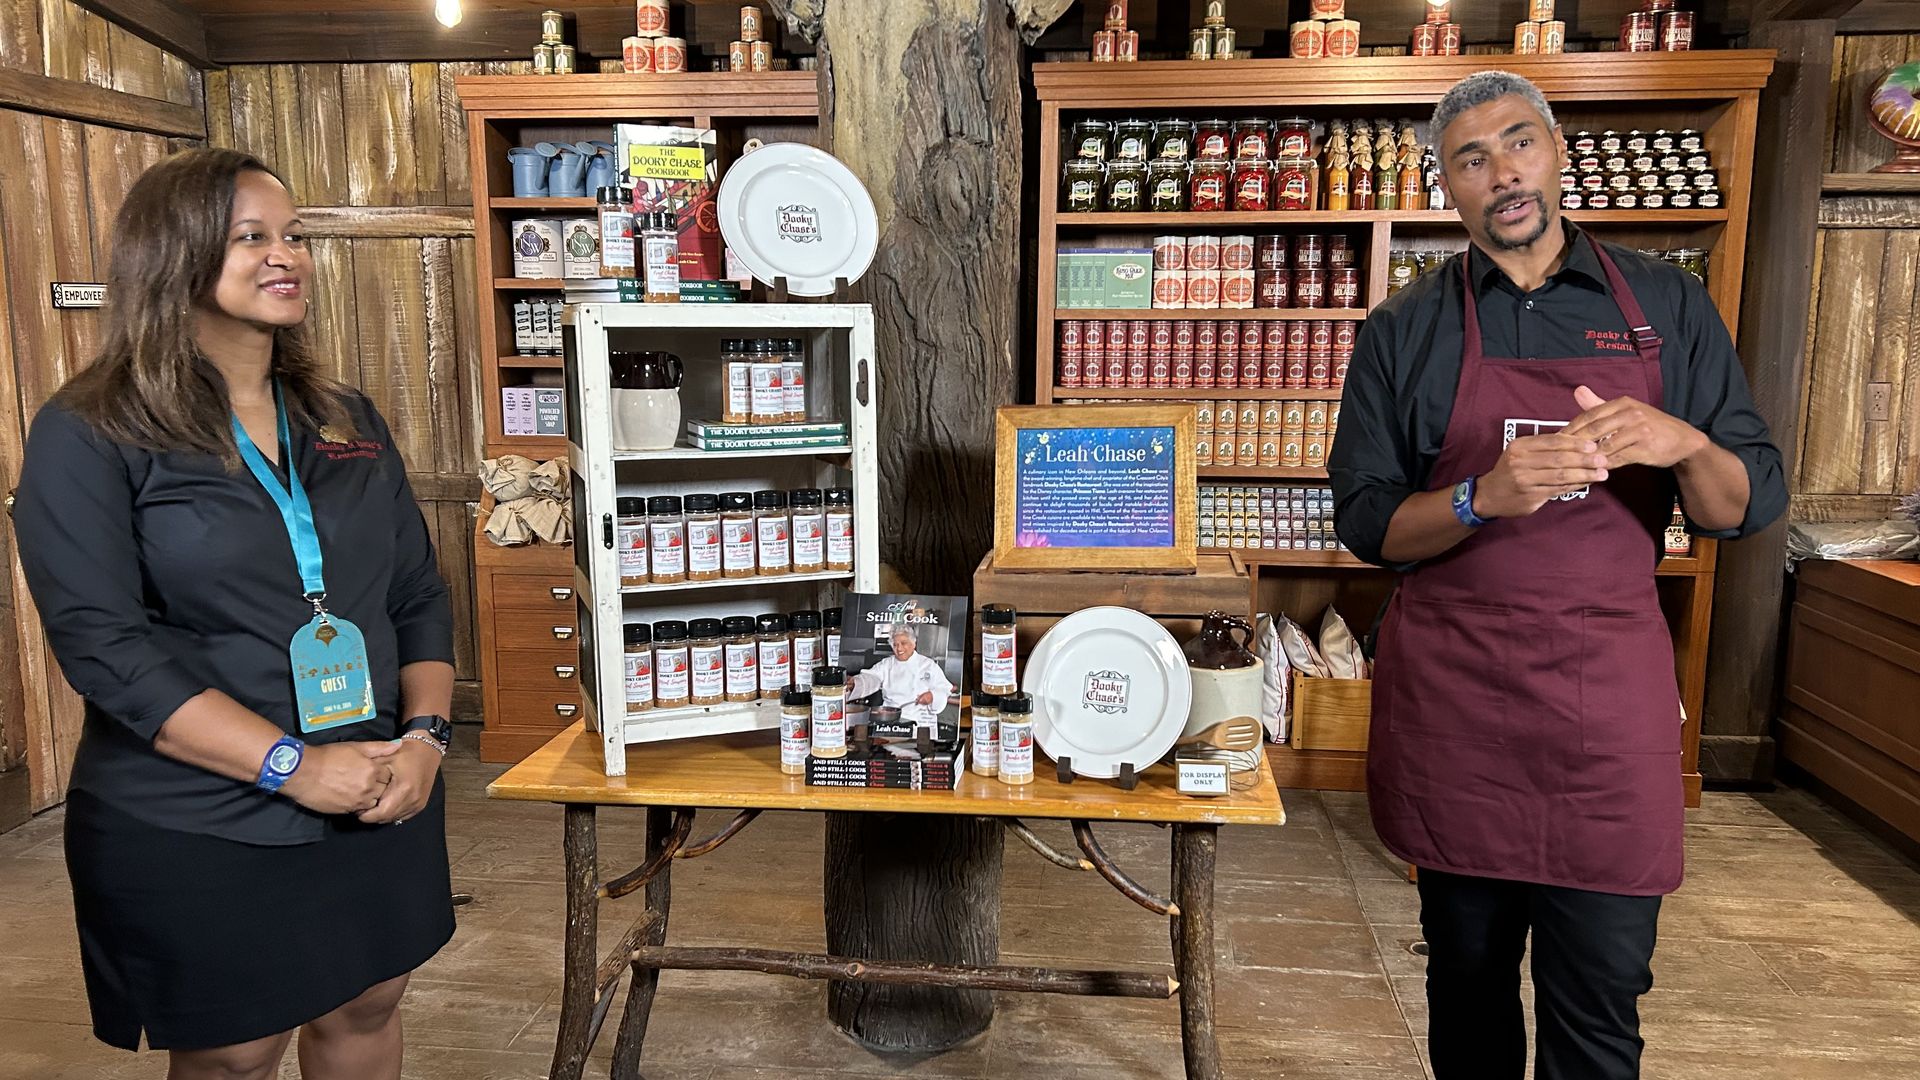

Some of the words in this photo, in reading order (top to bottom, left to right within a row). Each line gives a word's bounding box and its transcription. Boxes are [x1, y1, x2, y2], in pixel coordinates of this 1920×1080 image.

[633, 156, 667, 166] DOOKY
[670, 158, 702, 168] CHASE
[646, 168, 690, 176] COOKBOOK
[782, 212, 812, 226] Dooky
[780, 223, 816, 233] Chase's
[1585, 330, 1620, 340] Dooky
[1595, 341, 1634, 352] Restau
[1046, 445, 1088, 462] Leah
[1094, 444, 1146, 462] Chase
[888, 601, 916, 612] And
[866, 612, 893, 622] Still
[896, 613, 900, 623] I
[904, 614, 938, 624] Cook
[320, 675, 348, 694] GUEST
[1091, 678, 1122, 694] Dooky
[1086, 690, 1124, 703] Chase's
[892, 725, 910, 733] Chase
